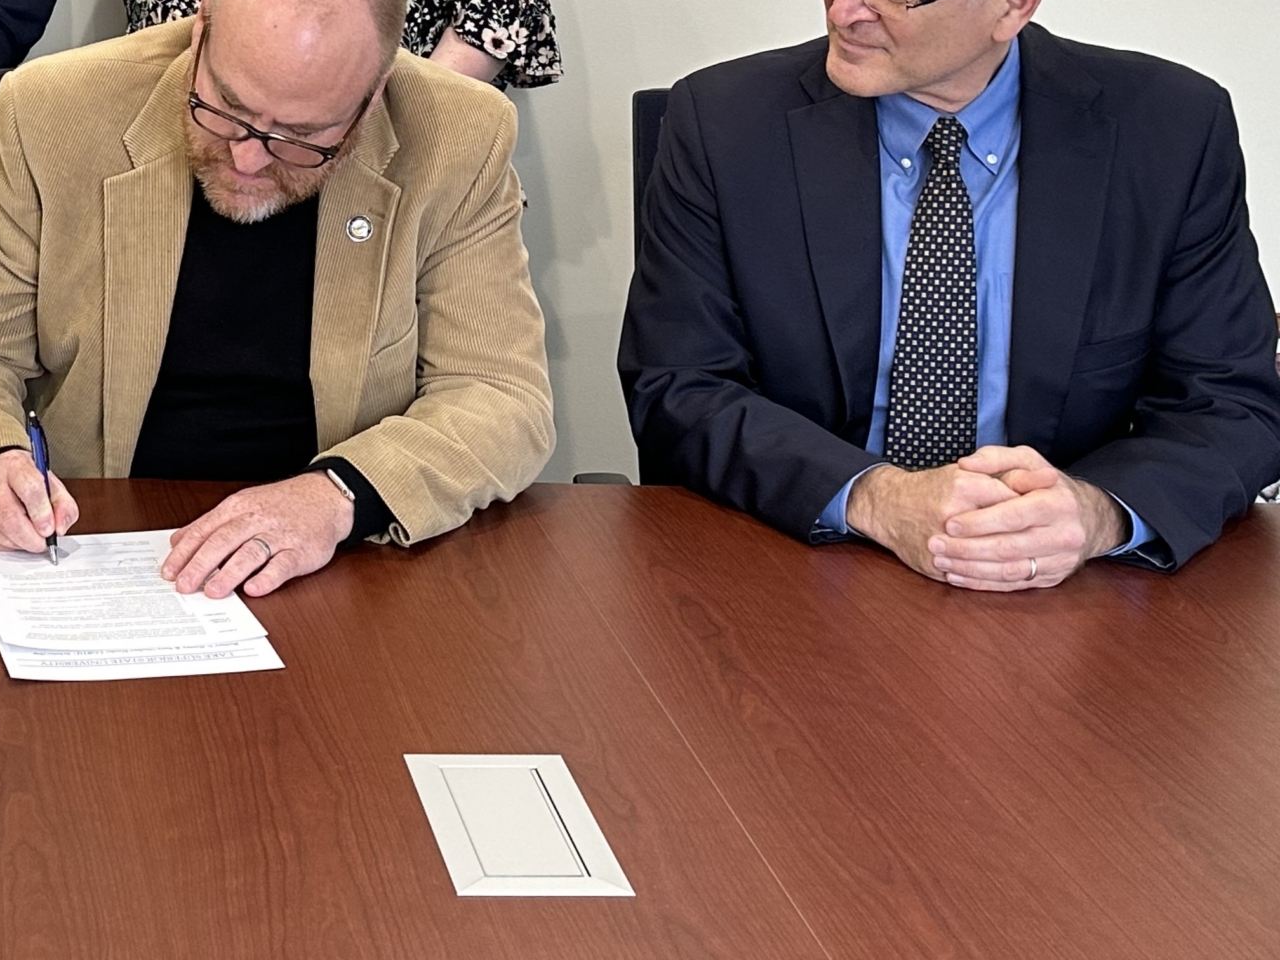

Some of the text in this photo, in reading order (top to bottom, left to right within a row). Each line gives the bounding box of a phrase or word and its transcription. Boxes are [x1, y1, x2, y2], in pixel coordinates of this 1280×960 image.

[145, 655, 202, 663] SUPERIOR
[204, 652, 235, 660] LAKE
[39, 658, 108, 666] UNIVERSITY
